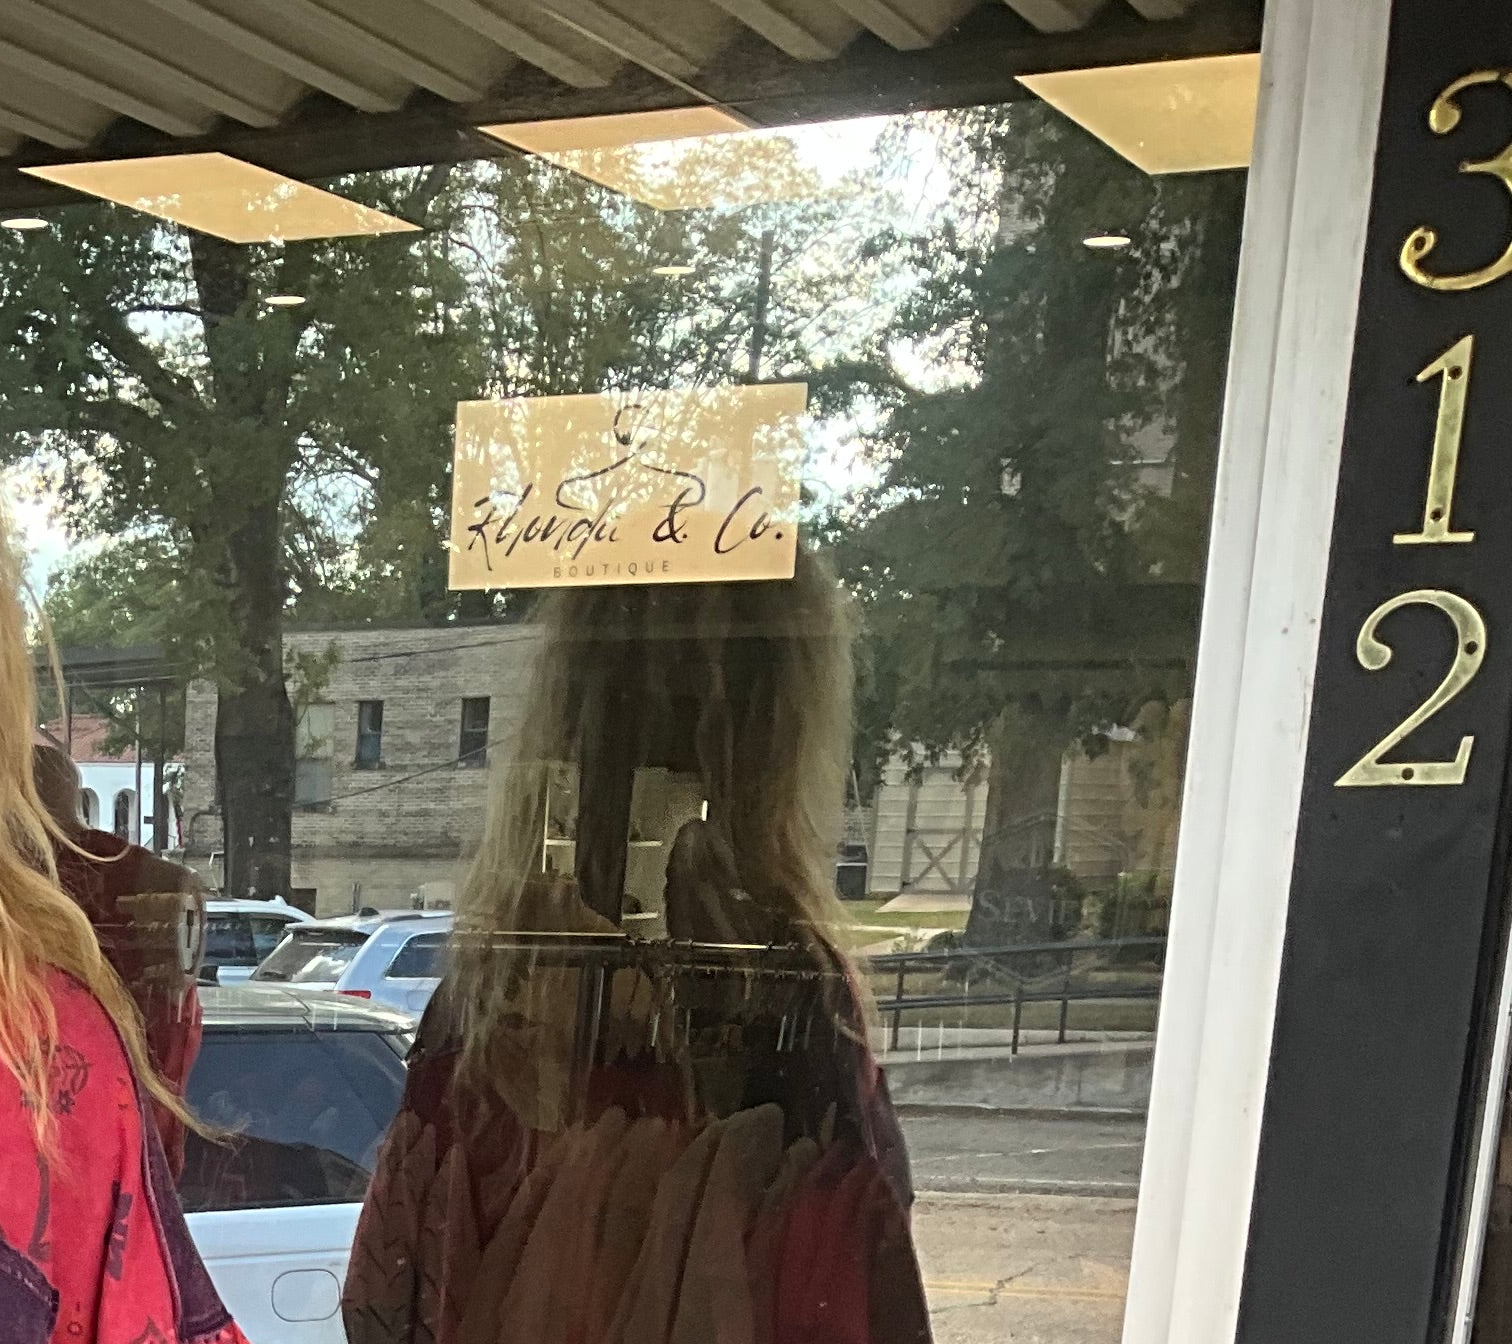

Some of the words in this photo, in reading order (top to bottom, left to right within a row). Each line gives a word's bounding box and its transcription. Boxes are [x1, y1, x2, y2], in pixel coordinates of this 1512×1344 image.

[1334, 69, 1512, 788] 312
[652, 488, 690, 543] &
[714, 486, 784, 555] Co.
[553, 559, 672, 579] BOUTIQUE
